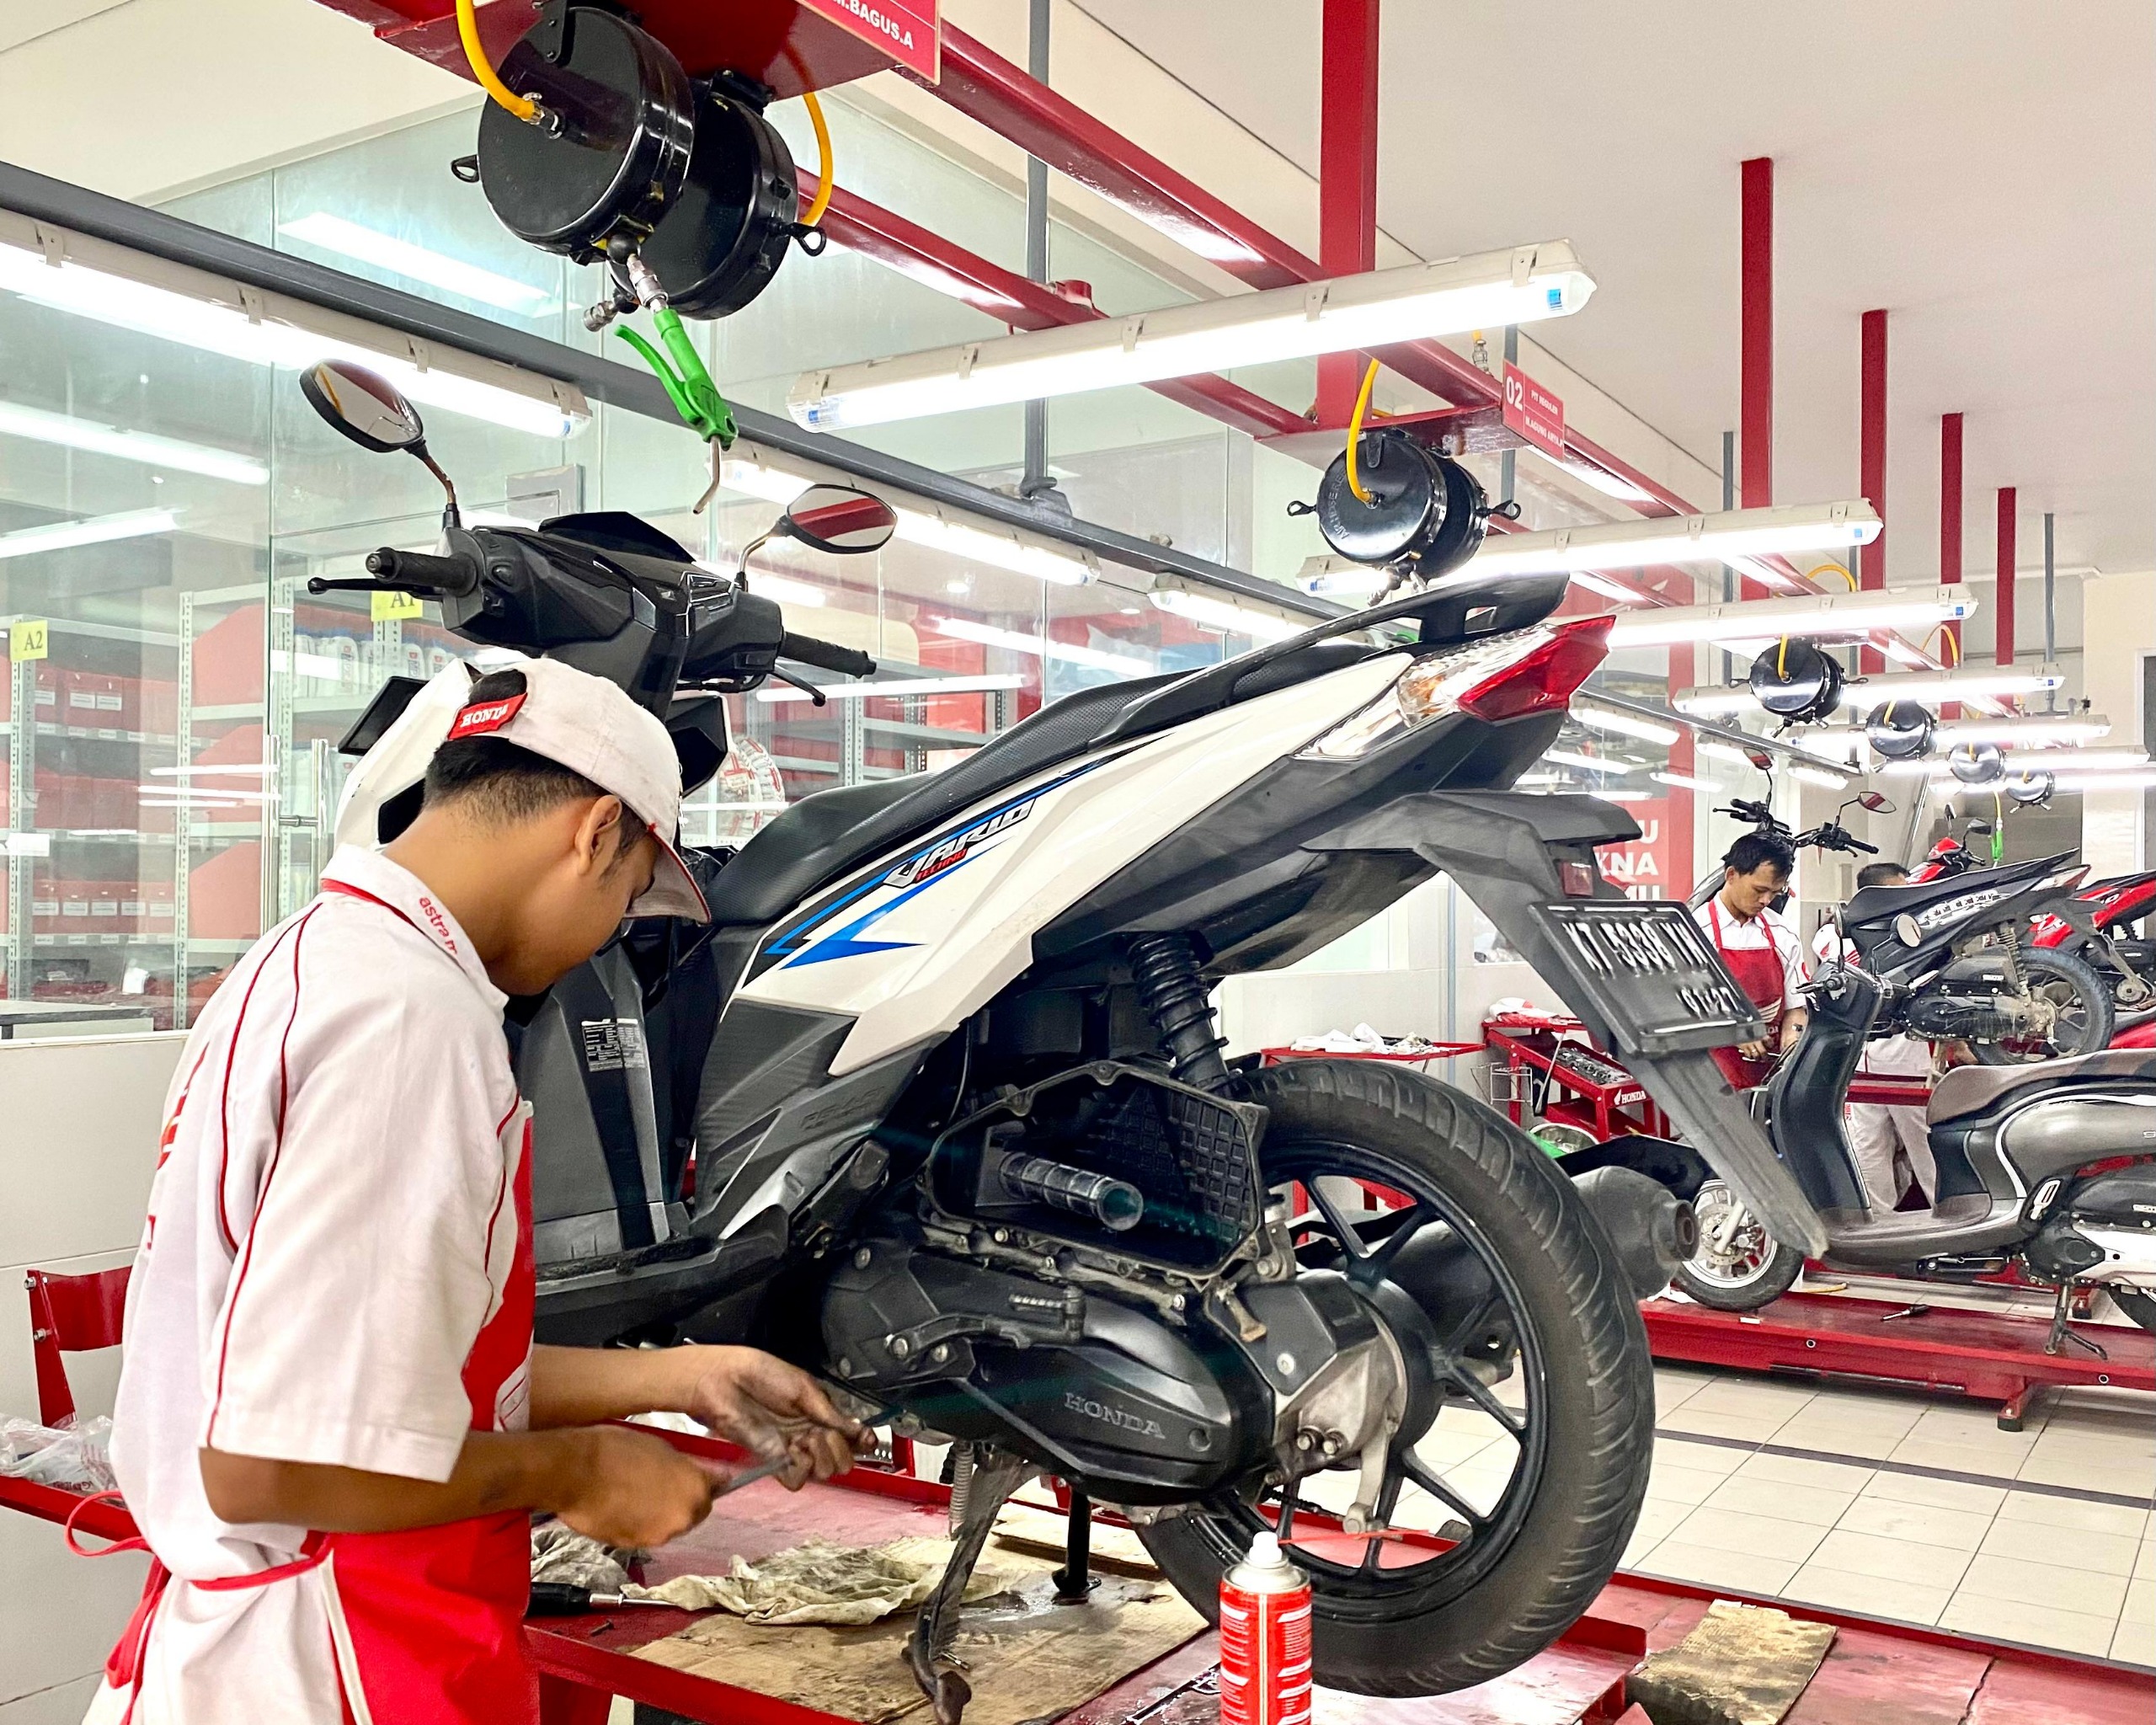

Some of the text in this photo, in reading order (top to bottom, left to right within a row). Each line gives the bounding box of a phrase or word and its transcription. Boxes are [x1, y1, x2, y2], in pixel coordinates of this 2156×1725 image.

[1506, 376, 1524, 412] 02
[24, 630, 44, 651] A2
[883, 798, 1037, 889] VARIO
[419, 897, 450, 937] astra
[1561, 921, 1708, 971] KT 5338 YH
[1622, 1090, 1647, 1104] HONDA
[1065, 1392, 1166, 1439] HONDA
